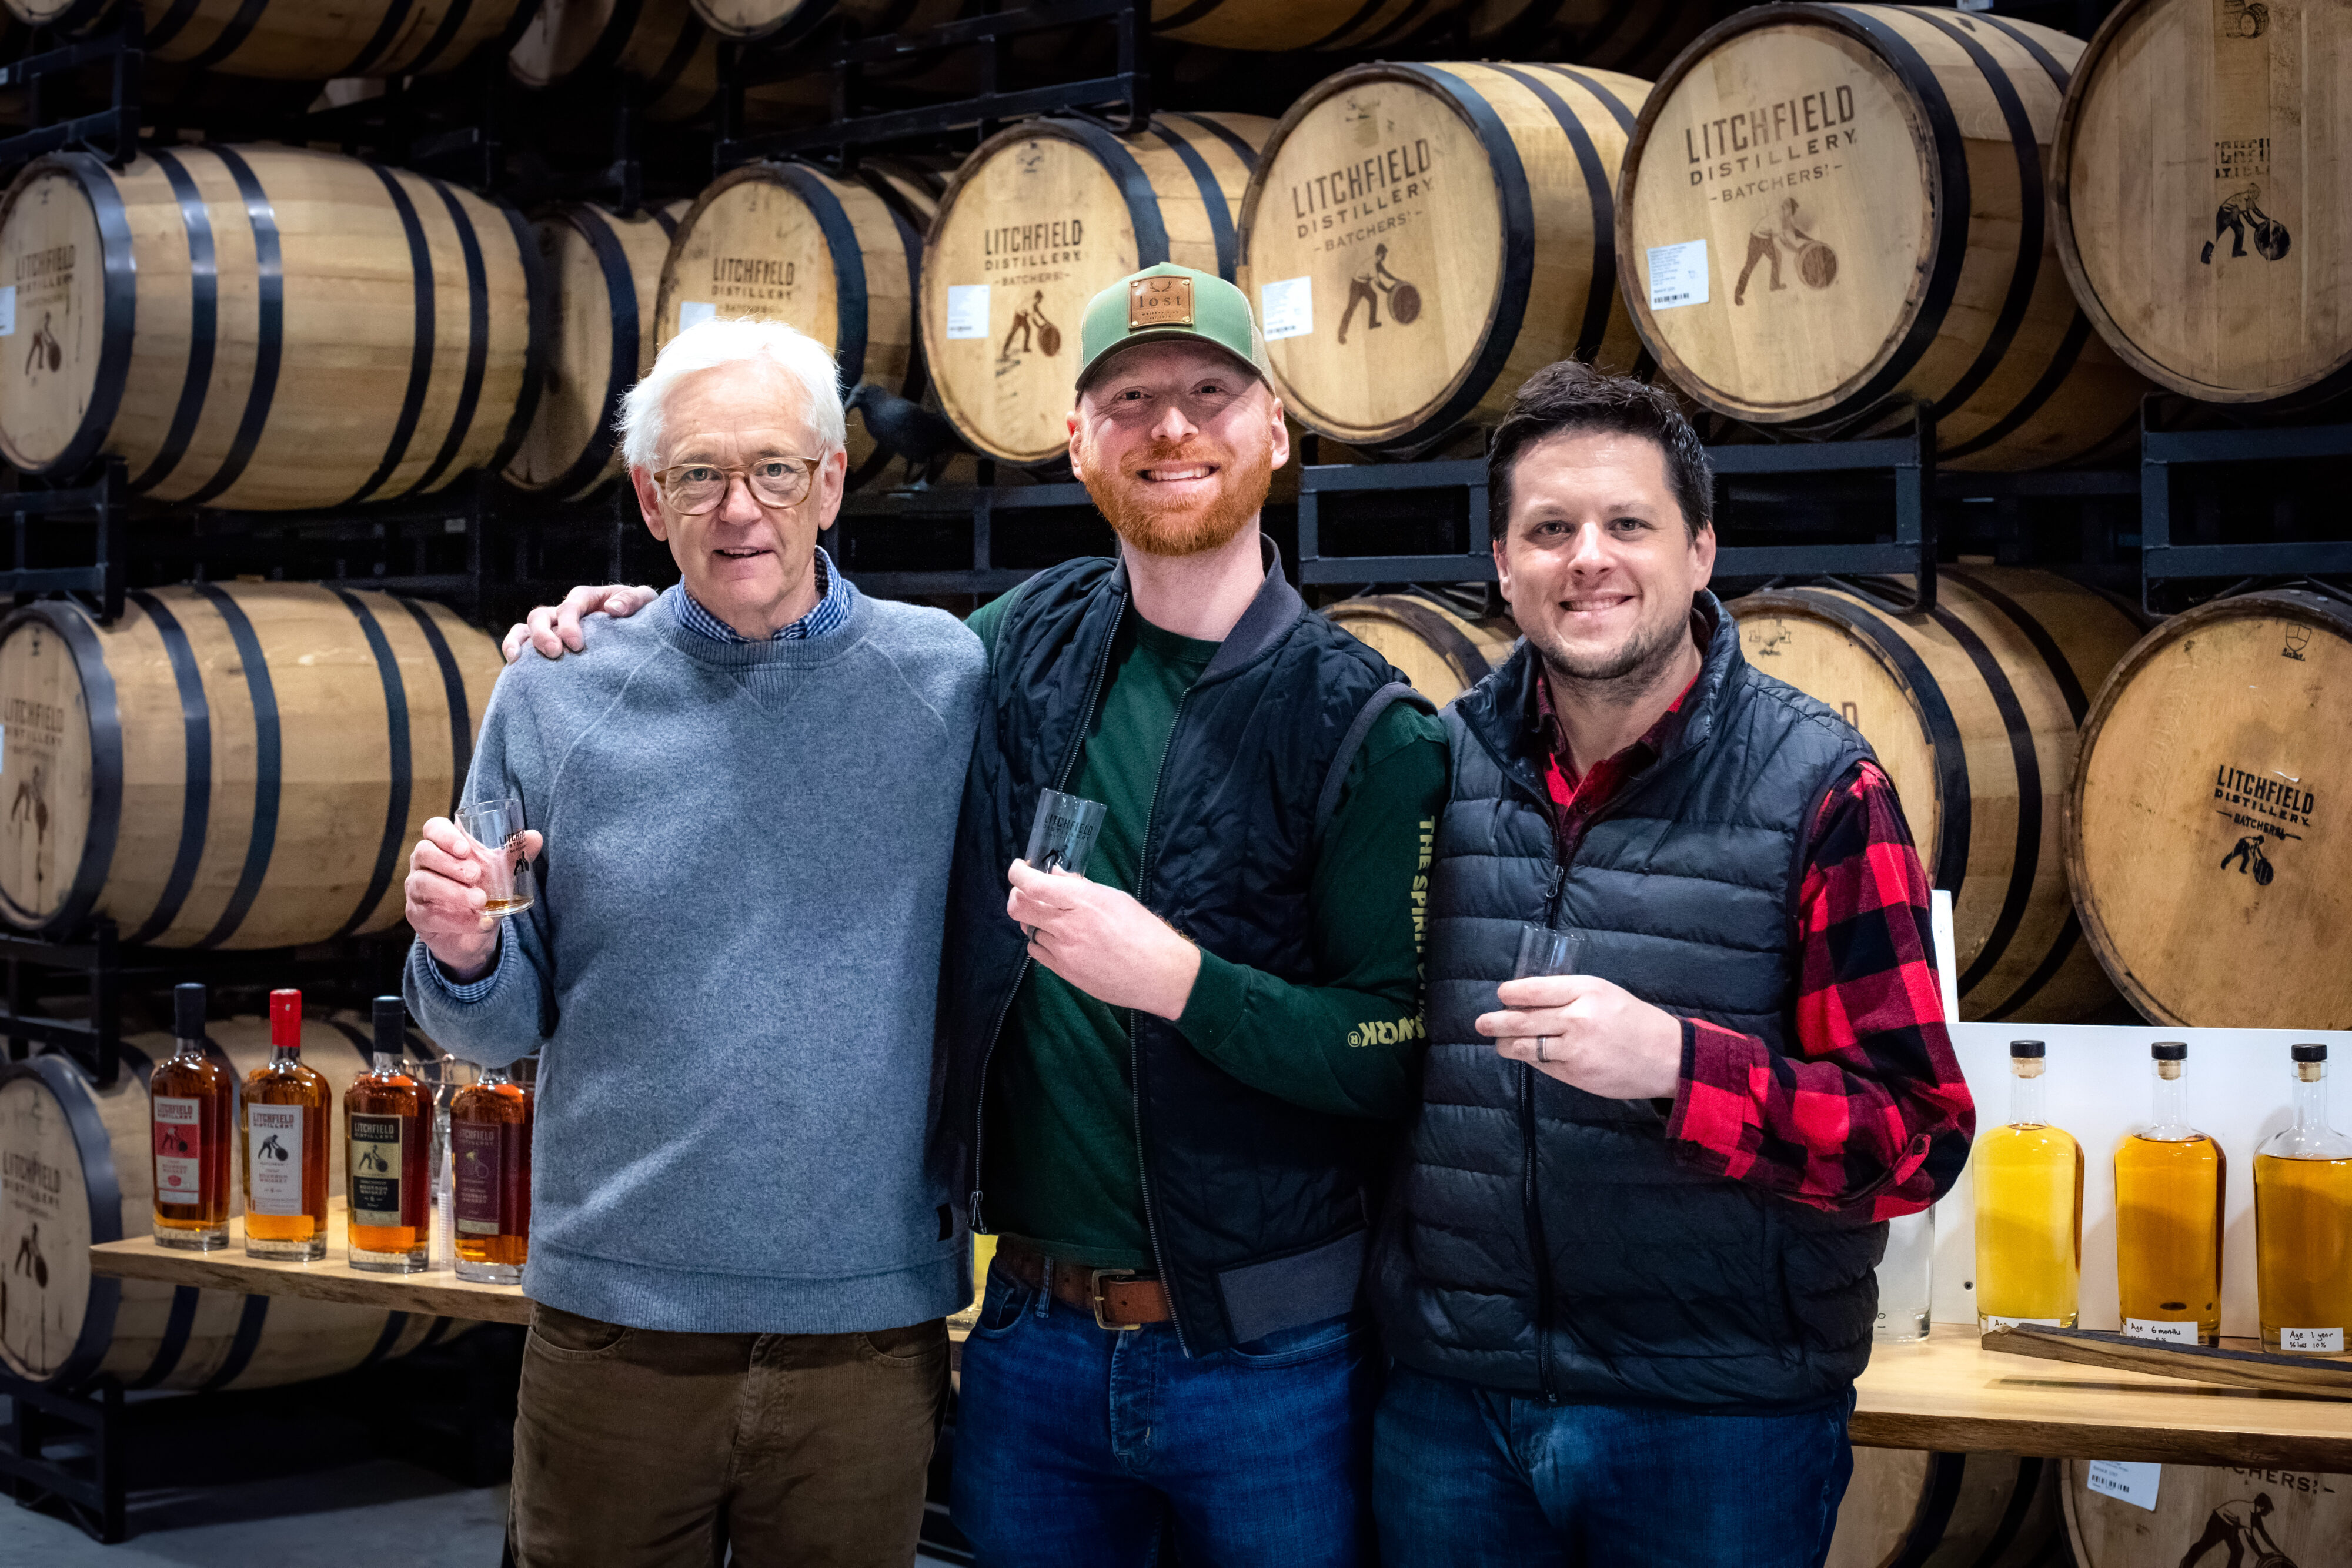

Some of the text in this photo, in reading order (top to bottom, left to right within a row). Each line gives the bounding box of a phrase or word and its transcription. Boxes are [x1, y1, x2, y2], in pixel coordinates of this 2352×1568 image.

[1686, 85, 1855, 165] LITCHFIELD
[1690, 129, 1856, 186] DISTILLERY
[1292, 138, 1431, 218] LITCHFIELD
[1297, 178, 1432, 239] DISTILLERY
[984, 219, 1083, 255] LITCHFIELD
[713, 257, 795, 286] LITCHFIELD
[985, 250, 1081, 270] DISTILLERY
[1140, 295, 1182, 308] lost
[2217, 765, 2314, 815] LITCHFIELD
[2214, 788, 2310, 827] DISTILLERY
[1045, 813, 1093, 835] LITCHFIELD
[1418, 815, 1435, 871] THE
[157, 1102, 193, 1115] LITCHFIELD
[253, 1112, 294, 1124] LITCHFIELD
[354, 1122, 395, 1134] LITCHFIELD
[2, 1149, 61, 1194] LITCHFIELD
[2131, 1322, 2143, 1332] Age
[2290, 1330, 2303, 1340] Age
[2317, 1333, 2333, 1341] year
